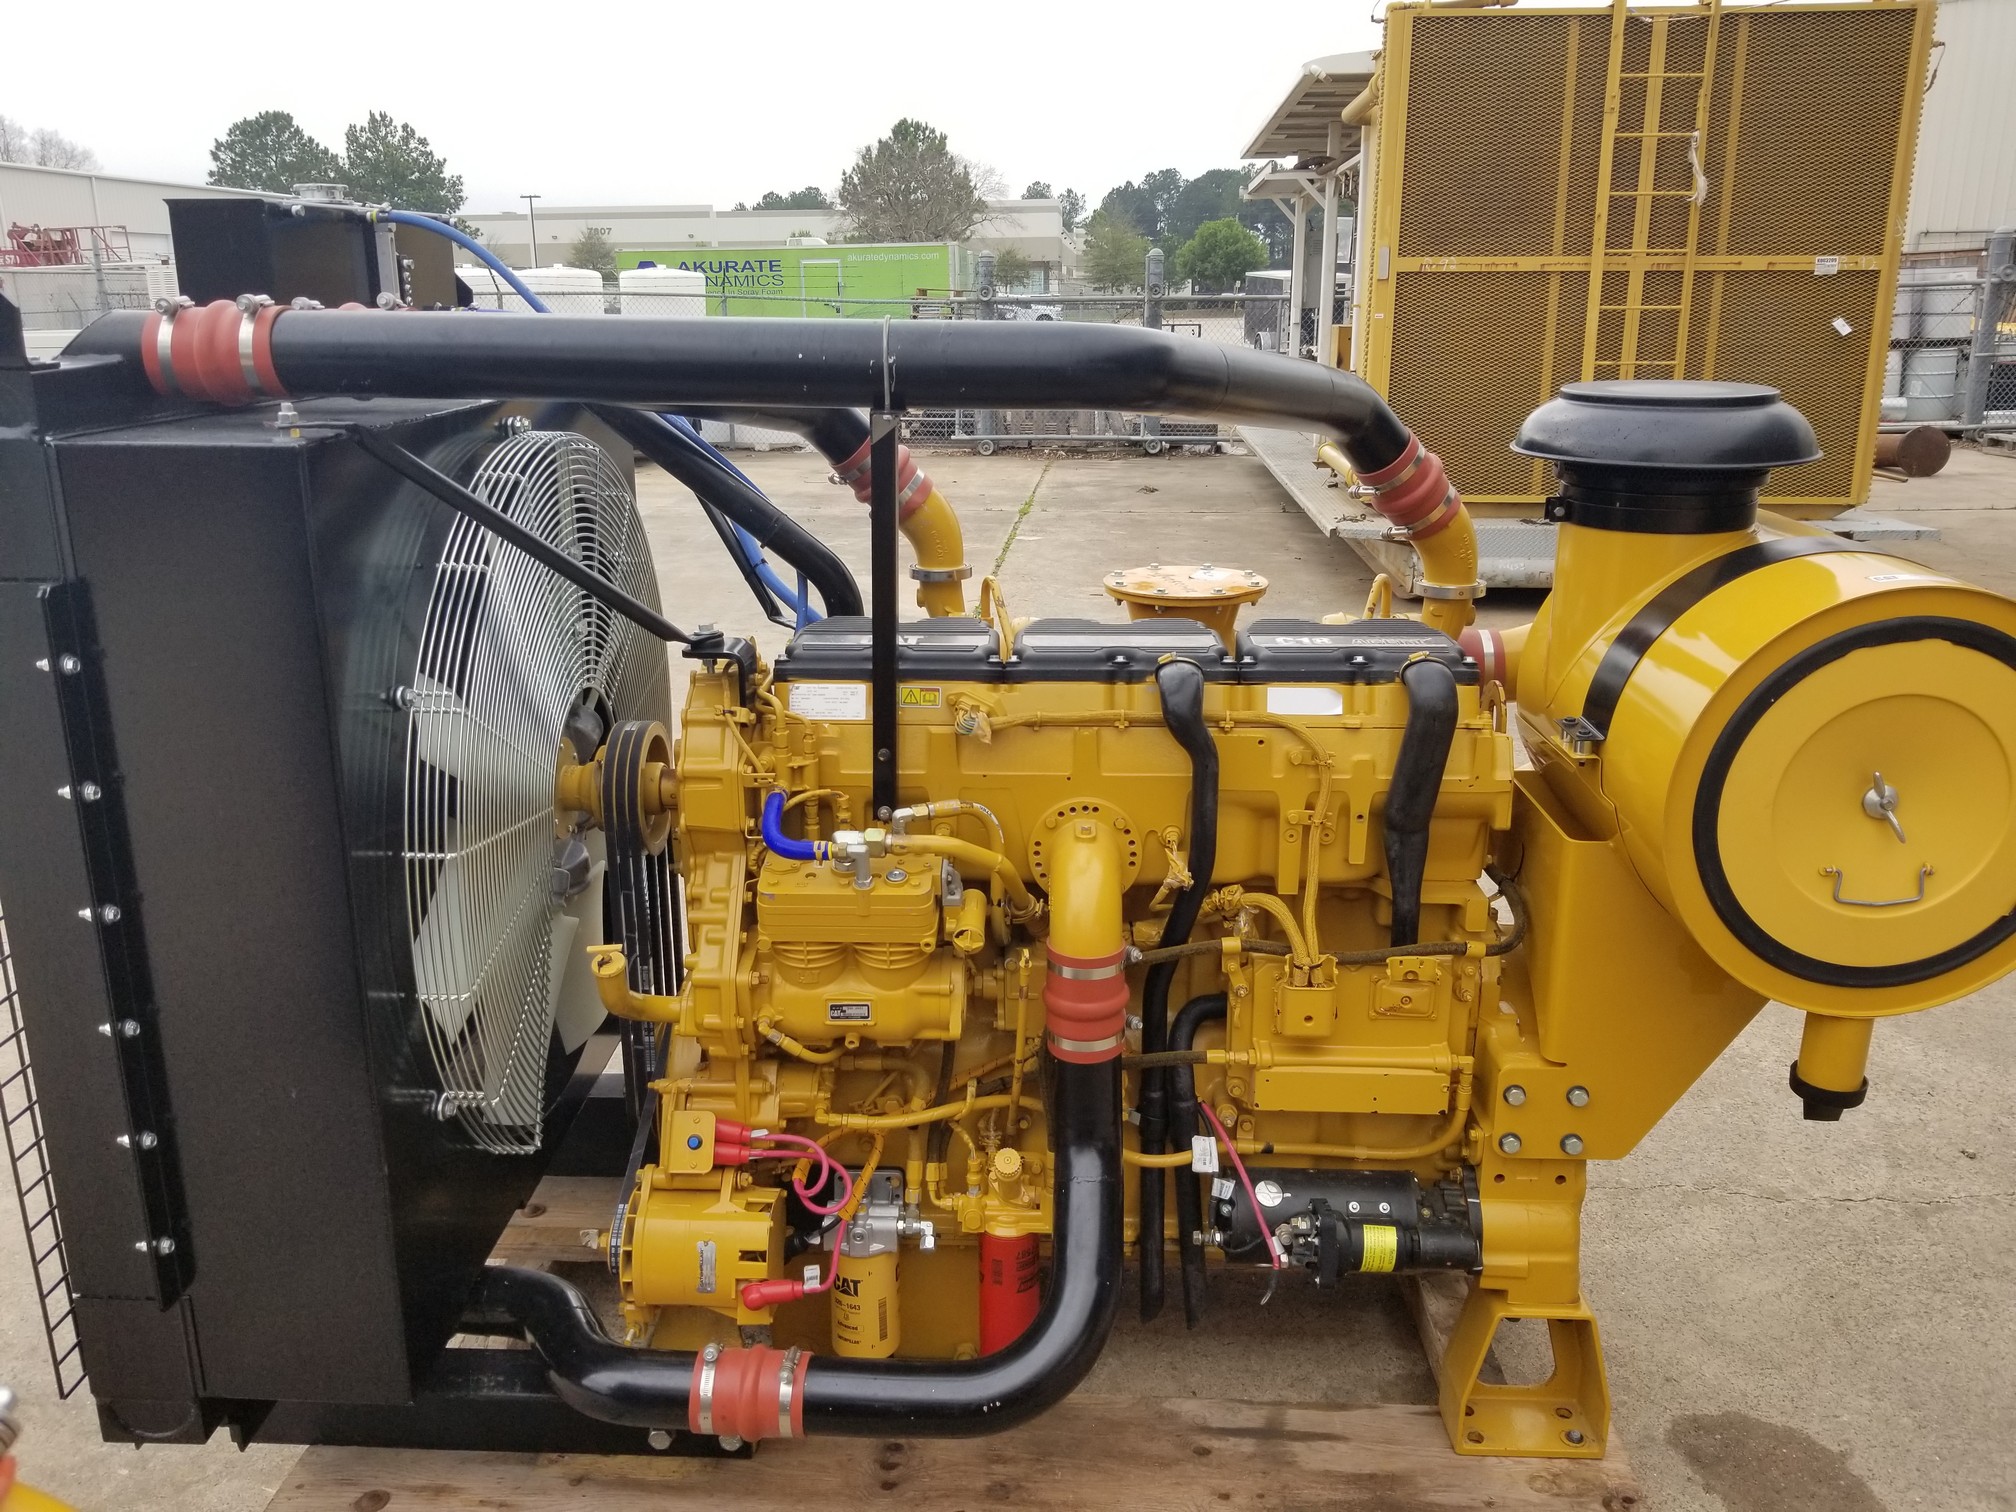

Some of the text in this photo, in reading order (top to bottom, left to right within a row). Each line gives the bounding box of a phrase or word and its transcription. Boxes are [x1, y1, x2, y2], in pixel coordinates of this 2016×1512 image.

[847, 252, 939, 263] akuratedynamics.com
[678, 259, 782, 274] AKURATE
[705, 274, 784, 287] NAMICS
[737, 288, 759, 296] Spray
[833, 1272, 862, 1298] CAT
